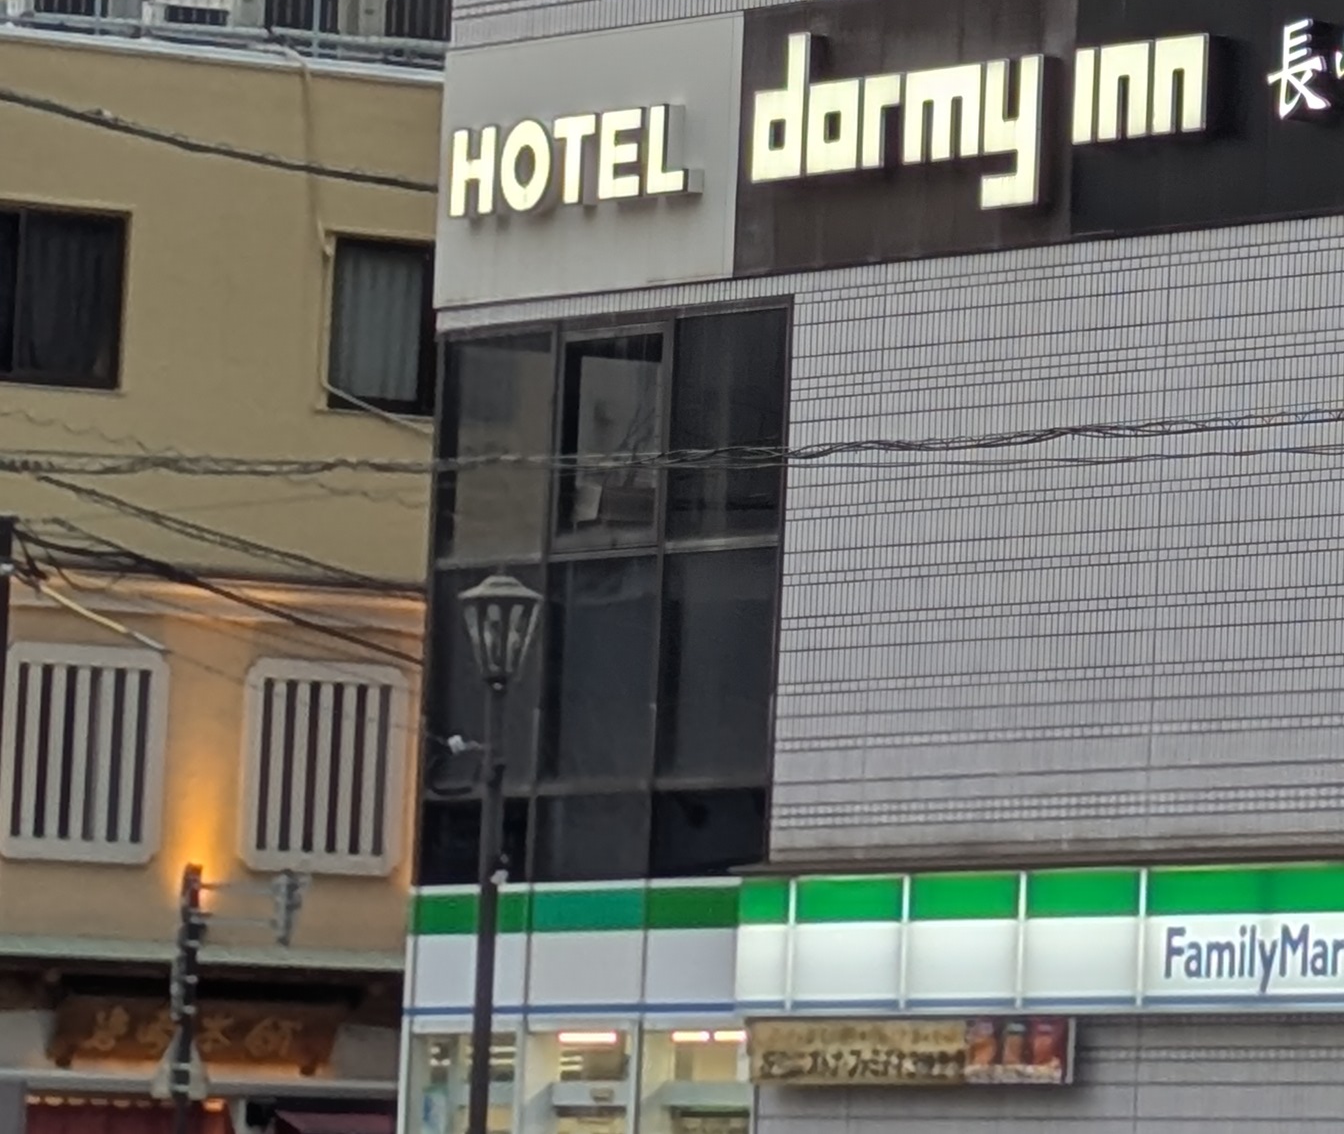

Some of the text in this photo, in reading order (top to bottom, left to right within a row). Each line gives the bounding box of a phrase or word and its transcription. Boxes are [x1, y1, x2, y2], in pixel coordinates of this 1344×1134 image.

[449, 104, 692, 218] HOTEL
[751, 32, 1045, 210] dormy
[1072, 33, 1210, 145] inn
